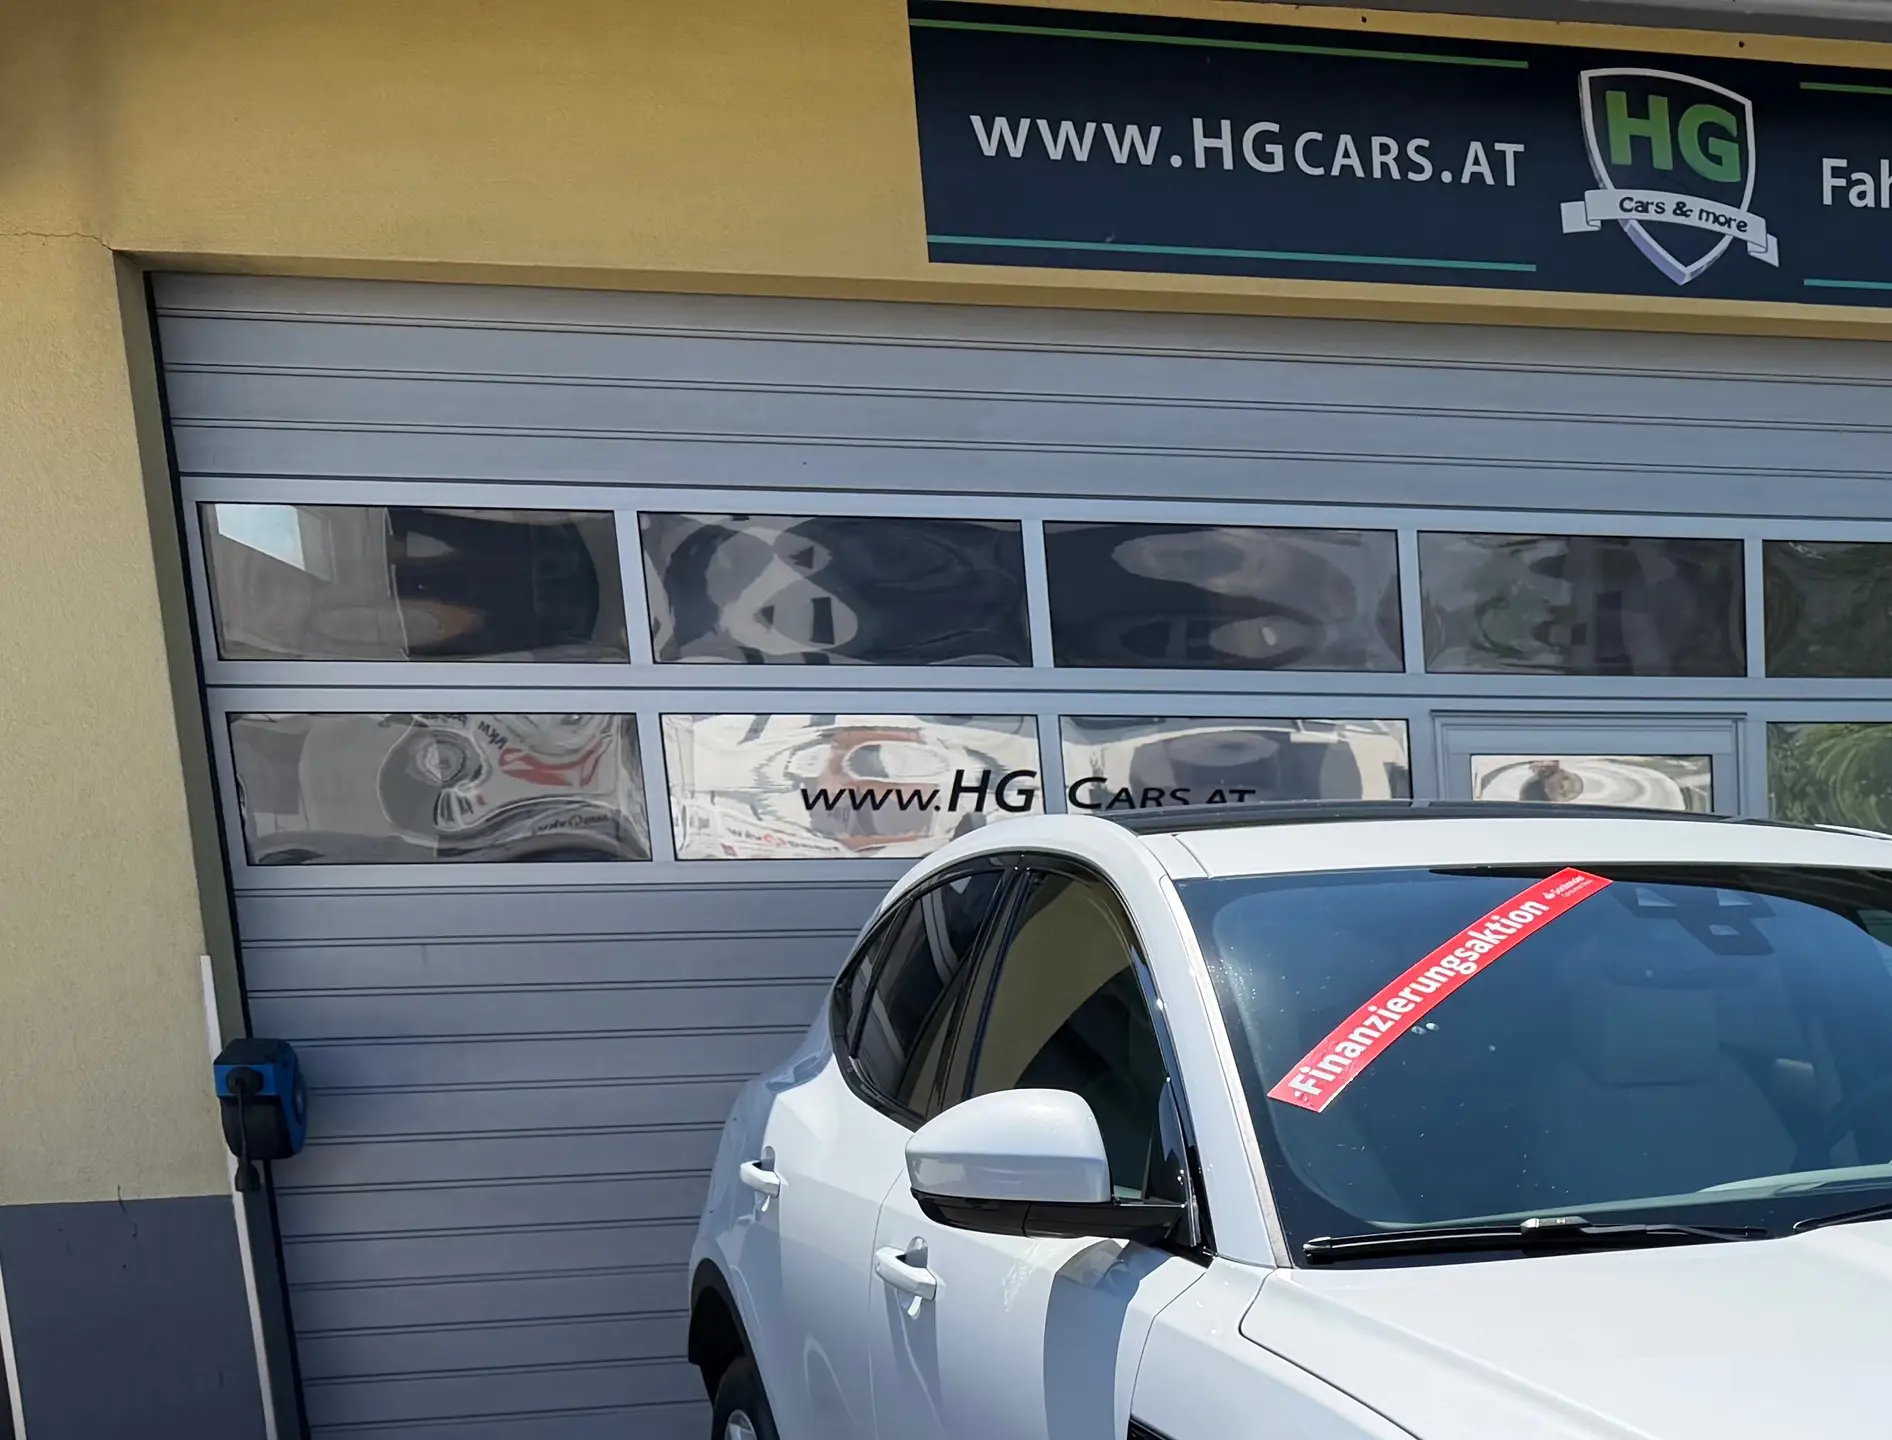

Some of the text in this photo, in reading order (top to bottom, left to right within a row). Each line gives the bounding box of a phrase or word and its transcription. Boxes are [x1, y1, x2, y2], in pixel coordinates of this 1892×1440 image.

[1605, 90, 1742, 183] HG
[1619, 197, 1748, 233] Cars & more
[1288, 899, 1550, 1097] Finanzierungsaktion
